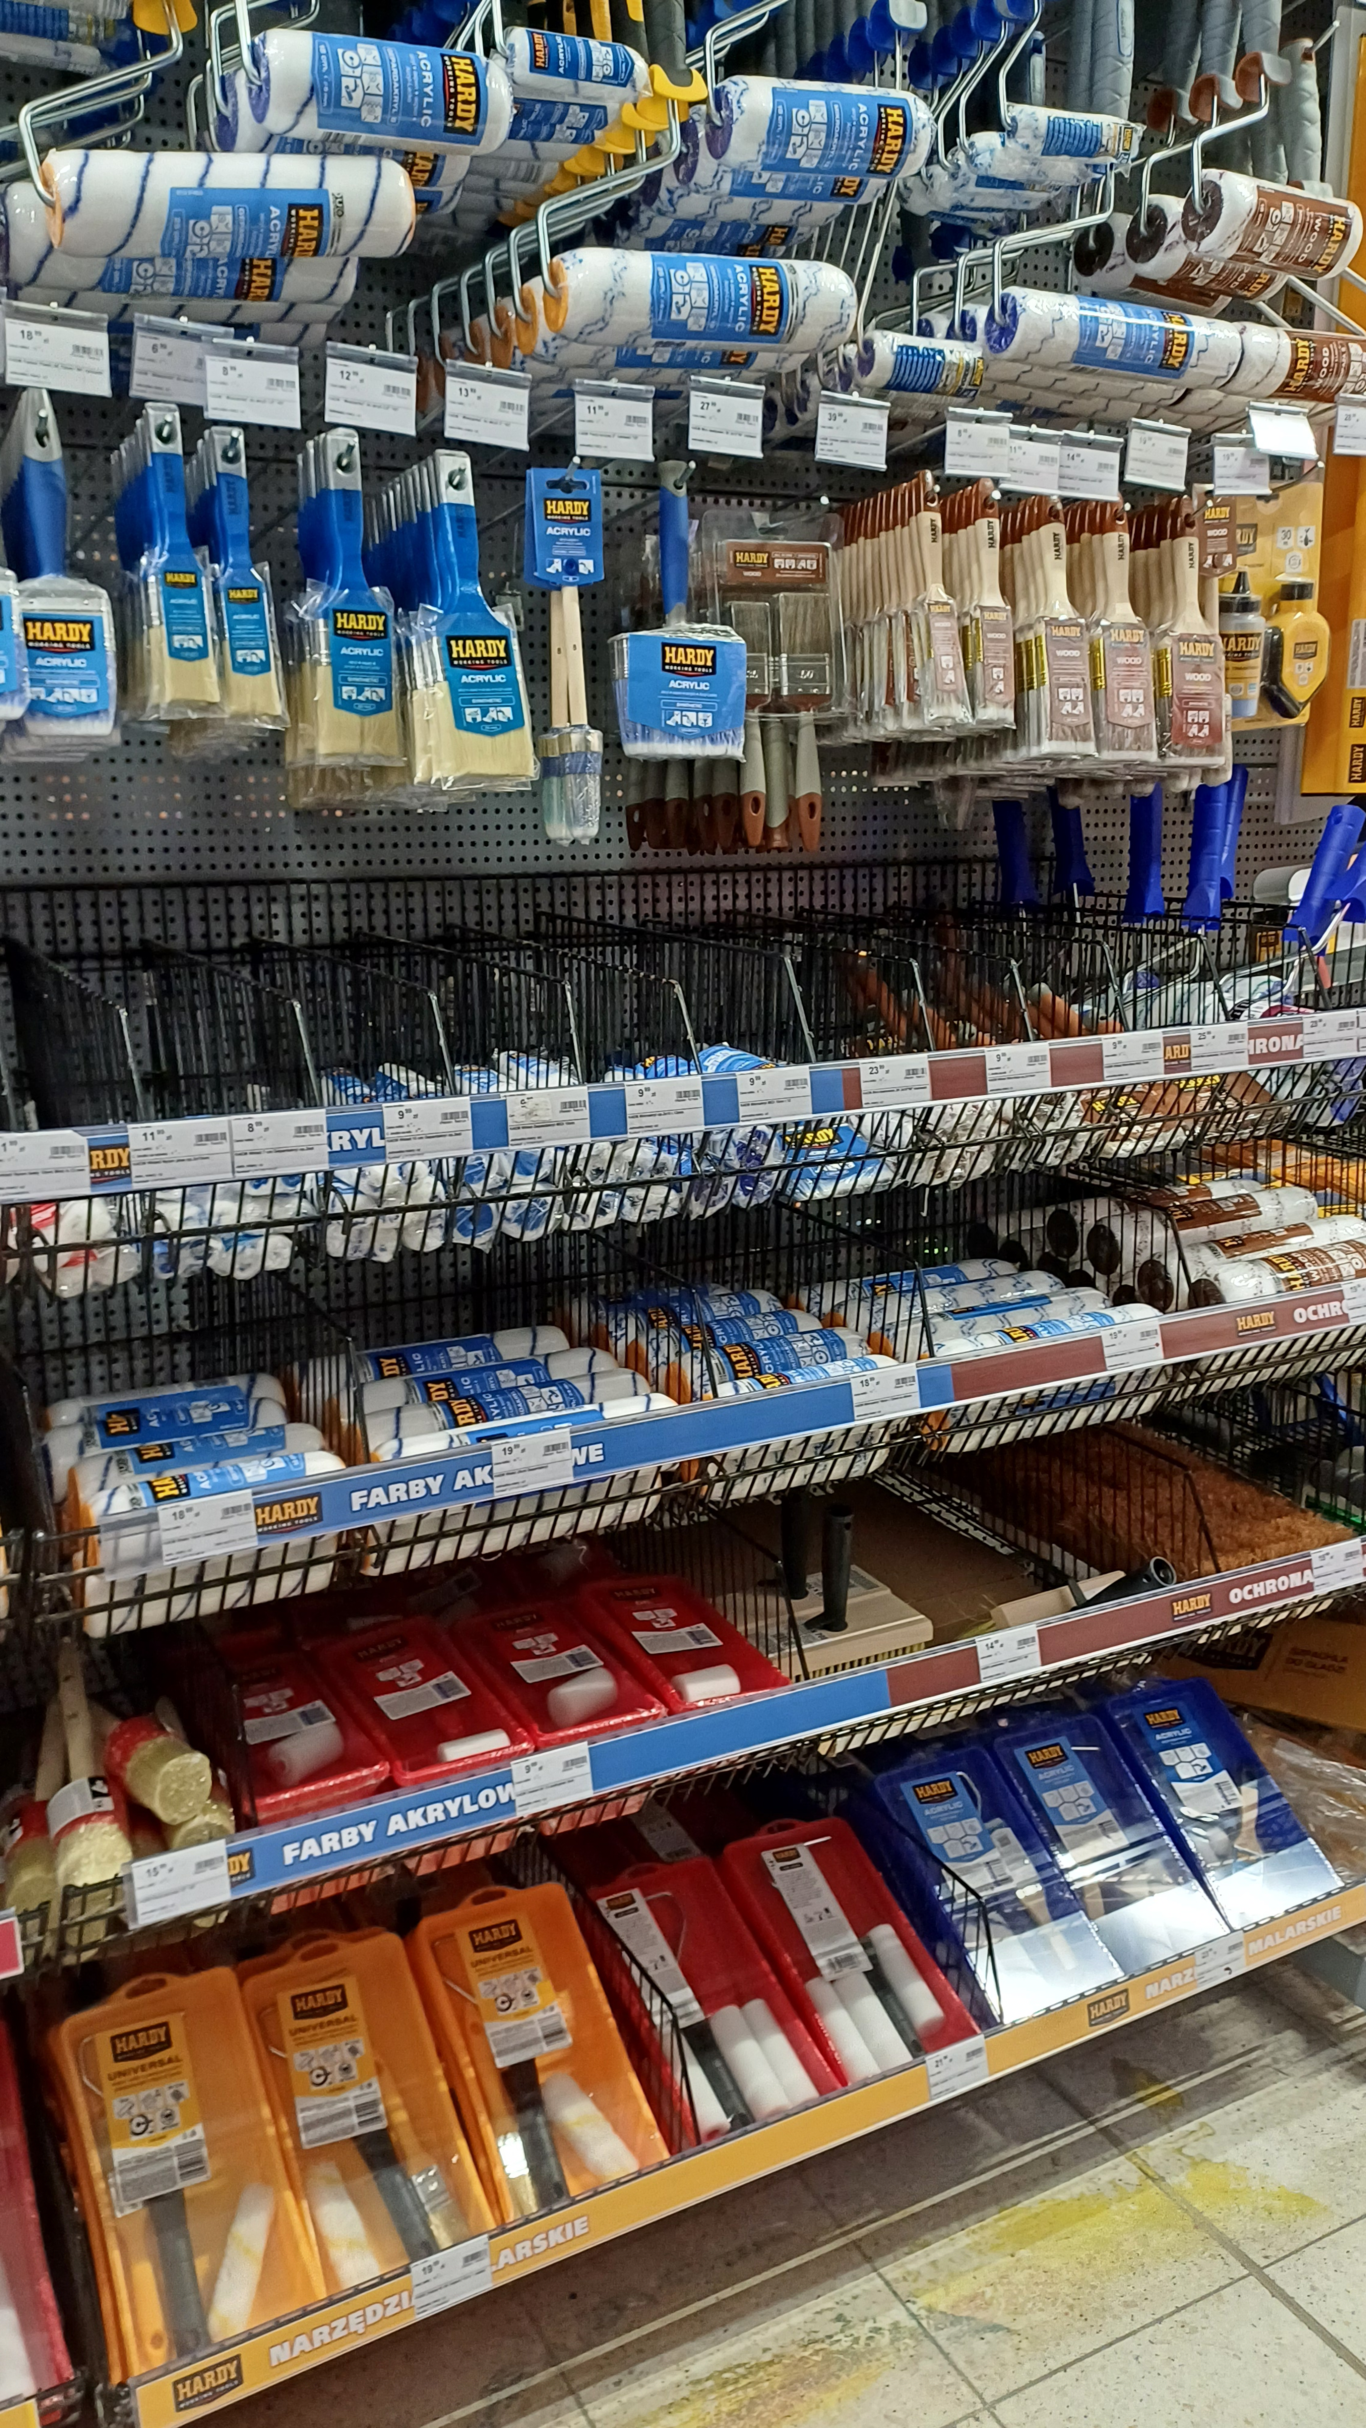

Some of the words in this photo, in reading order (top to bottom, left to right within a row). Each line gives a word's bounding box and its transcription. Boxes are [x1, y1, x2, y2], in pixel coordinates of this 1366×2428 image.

[533, 32, 546, 68] HARDY
[416, 50, 434, 128] ACRYLIC
[451, 56, 477, 133] HARDY
[848, 103, 869, 171] ACRYLIC
[876, 107, 903, 174] HARDY
[1299, 216, 1322, 262] WOOD
[1313, 215, 1345, 273] HARDY
[733, 264, 749, 332] ACRYLIC
[758, 267, 780, 334] HARDY
[1284, 338, 1311, 392] HARDY
[1314, 346, 1330, 390] WOOD
[546, 500, 589, 515] HARDY
[1204, 507, 1230, 520] HARDY
[546, 526, 591, 537] ACRYLIC
[1237, 527, 1256, 546] RDY
[1280, 529, 1292, 540] 30
[736, 551, 768, 564] HARDY
[228, 588, 259, 600] HARDY
[25, 621, 92, 642] HARDY
[336, 612, 385, 631] HARDY
[1051, 625, 1081, 637] HARDY
[1110, 628, 1145, 643] HARDY
[340, 646, 384, 657] ACRYLIC
[450, 639, 507, 658] HARDY
[664, 646, 714, 666] HARDY
[1179, 641, 1215, 657] HARDY
[35, 656, 87, 668] ACRYLIC
[461, 674, 507, 684] ACRYLIC
[668, 680, 710, 690] ACRYLIC
[1185, 672, 1212, 681] WOOD
[1351, 699, 1363, 727] HARDY
[1351, 746, 1364, 781] HARDY
[90, 1147, 130, 1170] RDY
[1236, 1311, 1275, 1331] HARDY
[351, 1473, 444, 1512] FARBY
[256, 1495, 318, 1526] HARDY
[1229, 1569, 1314, 1604] OCHRONA
[1172, 1593, 1211, 1616] HARDY
[1145, 1709, 1182, 1726] HARDY
[1155, 1728, 1192, 1742] ACRYLIC
[1028, 1745, 1063, 1764] HARDY
[1038, 1764, 1075, 1780] ACRYLIC
[915, 1781, 953, 1799] HARDY
[924, 1801, 964, 1816] ACRYLIC
[282, 1820, 377, 1866] FARBY
[387, 1782, 516, 1836] AKRYLOW
[473, 1923, 517, 1946] HARDY
[1248, 1905, 1342, 1957] MALARSKIE
[470, 1946, 533, 1968] UNIVERSAL
[295, 1988, 343, 2012] HARDY
[1089, 1989, 1129, 2020] HARDY
[288, 2014, 357, 2037] UNIVERSAL
[115, 2026, 167, 2054] HARDY
[107, 2055, 183, 2081] UNIVERSAL
[269, 2290, 413, 2367] NARZĘDZI
[490, 2215, 590, 2273] ARSKIE
[177, 2359, 239, 2401] HARDY
